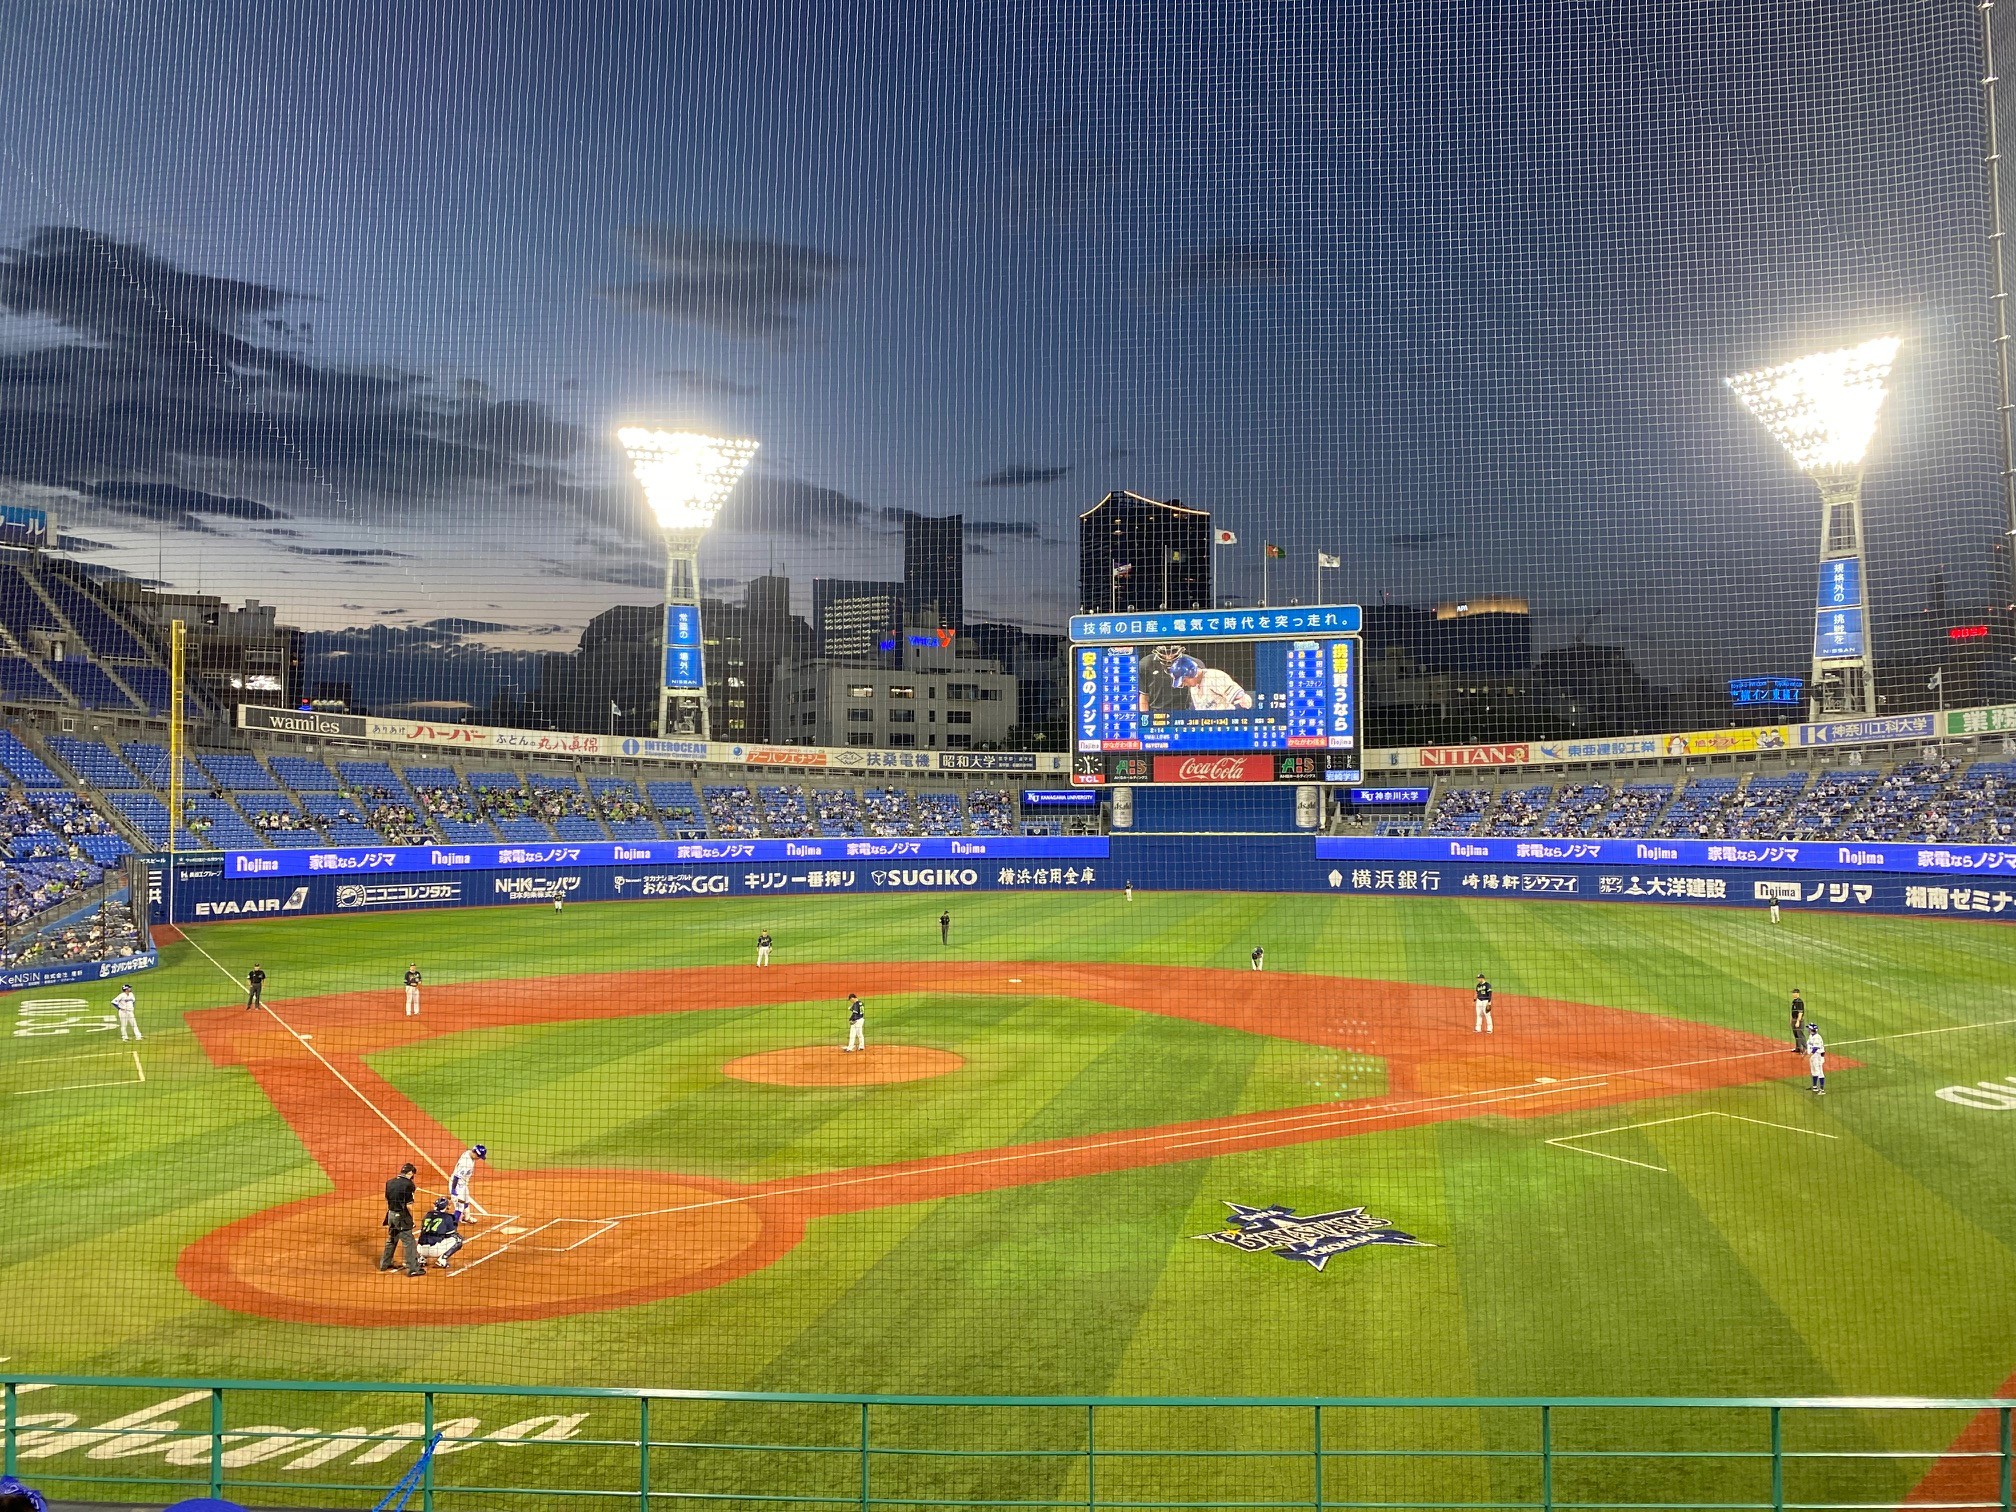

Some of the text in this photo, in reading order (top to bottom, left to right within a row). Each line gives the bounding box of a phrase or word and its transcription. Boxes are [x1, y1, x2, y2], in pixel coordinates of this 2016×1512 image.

[1834, 563, 1844, 602] 規格外の
[1083, 611, 1350, 634] 技術の日産。電気で時代を突っ走れ。
[908, 636, 939, 647] YMCA
[1082, 651, 1097, 737] 安心のノジマ
[269, 715, 340, 734] wamiles
[372, 724, 486, 742] ありあけ ハーバー
[1832, 717, 1927, 738] 神奈川工科大学
[1113, 732, 1136, 740] 小川
[644, 740, 707, 753] INTEROCEAN
[1568, 740, 1656, 757] 東亜建設工業
[942, 754, 996, 768] 昭和大学
[1421, 748, 1506, 765] NITTAN
[1375, 791, 1419, 801] 神奈川大学
[498, 848, 581, 864] 家電ならノジマ
[677, 844, 755, 860] 家電ならノジマ
[847, 842, 921, 856] 家電ならノジマ
[1516, 843, 1601, 859] 家電ならノジマ
[1707, 845, 1799, 863] 家電ならノジマ
[309, 852, 396, 870] 家電ならノジマ
[888, 869, 978, 886] SUGIKO
[997, 866, 1096, 885] 横浜信用金庫
[1351, 869, 1441, 890] 横浜銀行
[1462, 873, 1520, 890] 崎陽軒
[366, 885, 462, 900] ニコニコレンタカー
[1600, 885, 1622, 893] グループ
[1646, 876, 1727, 899] 大洋建設
[1806, 882, 1873, 904] ノジマ
[1905, 886, 2016, 913] 湘南ゼミナ
[1302, 1233, 1385, 1257] YOKOHAMA
